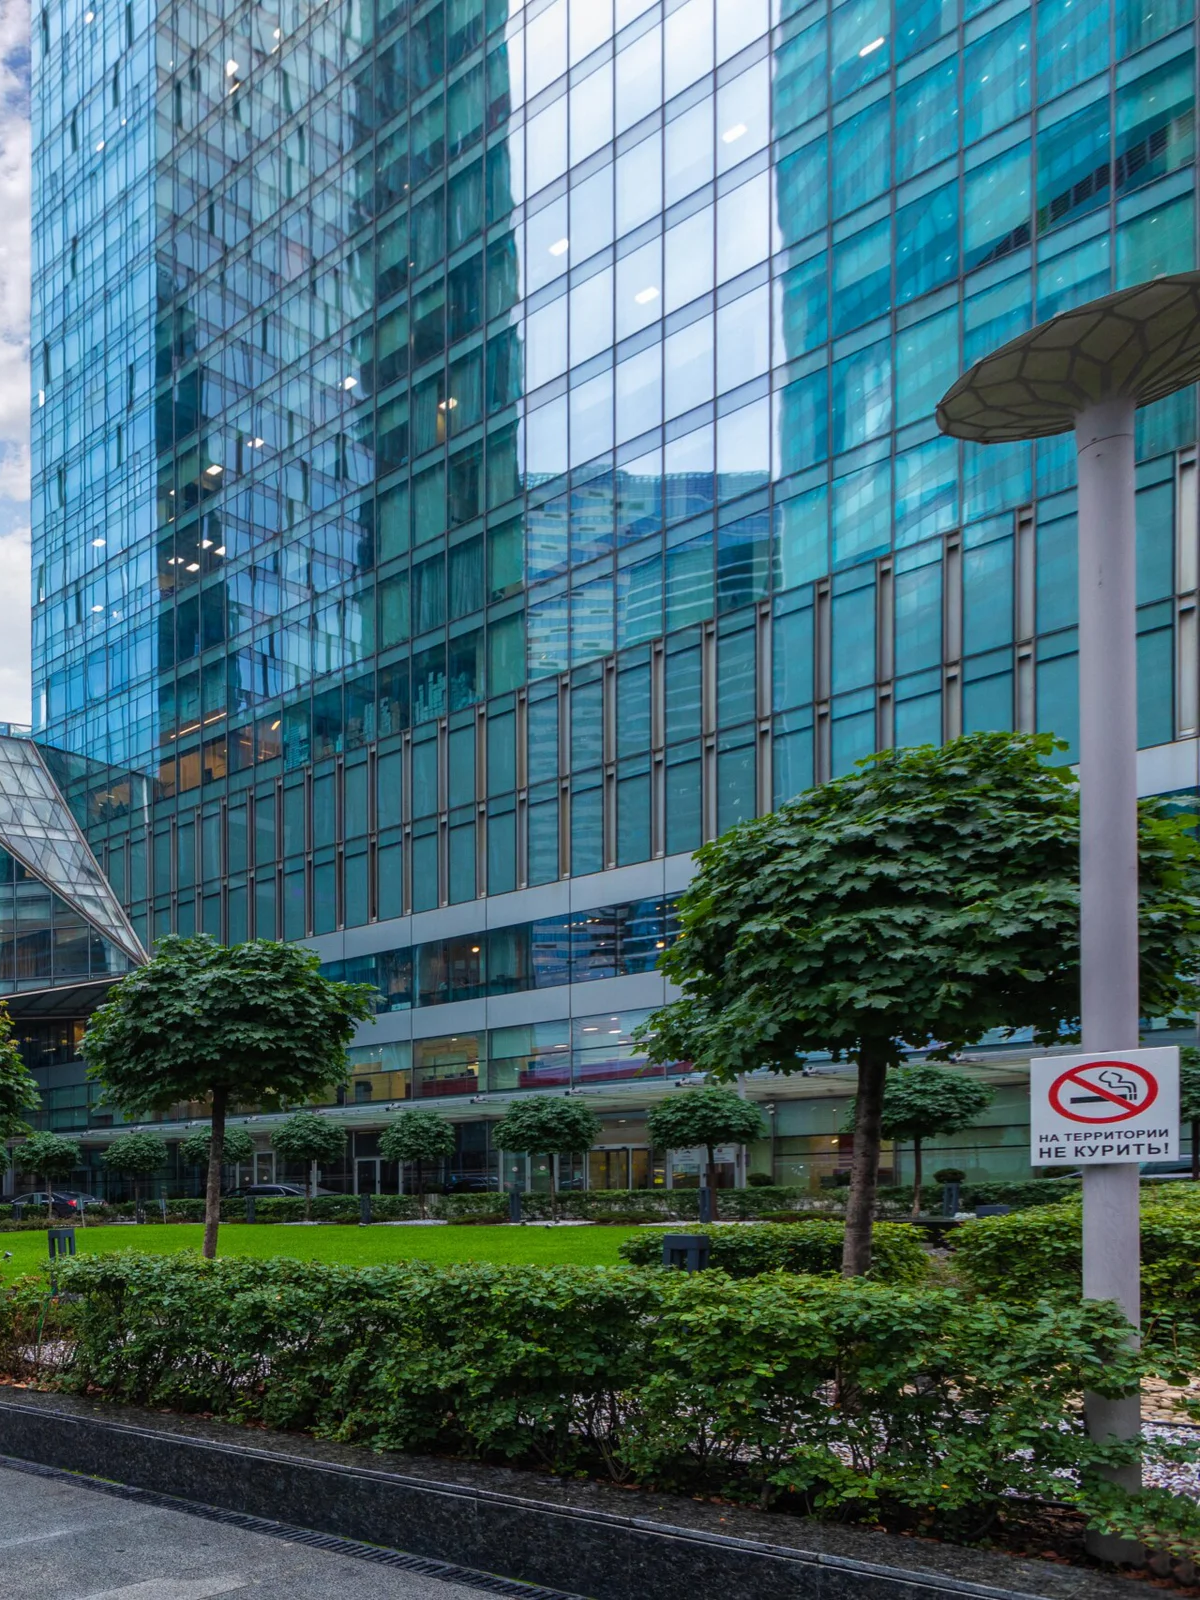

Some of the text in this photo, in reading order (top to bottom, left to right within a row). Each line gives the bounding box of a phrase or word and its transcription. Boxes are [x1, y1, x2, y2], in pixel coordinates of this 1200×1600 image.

[1039, 1129, 1169, 1143] НА ТЕРРИТОРИИ
[1039, 1142, 1169, 1158] НЕ КУРИТЬ!
